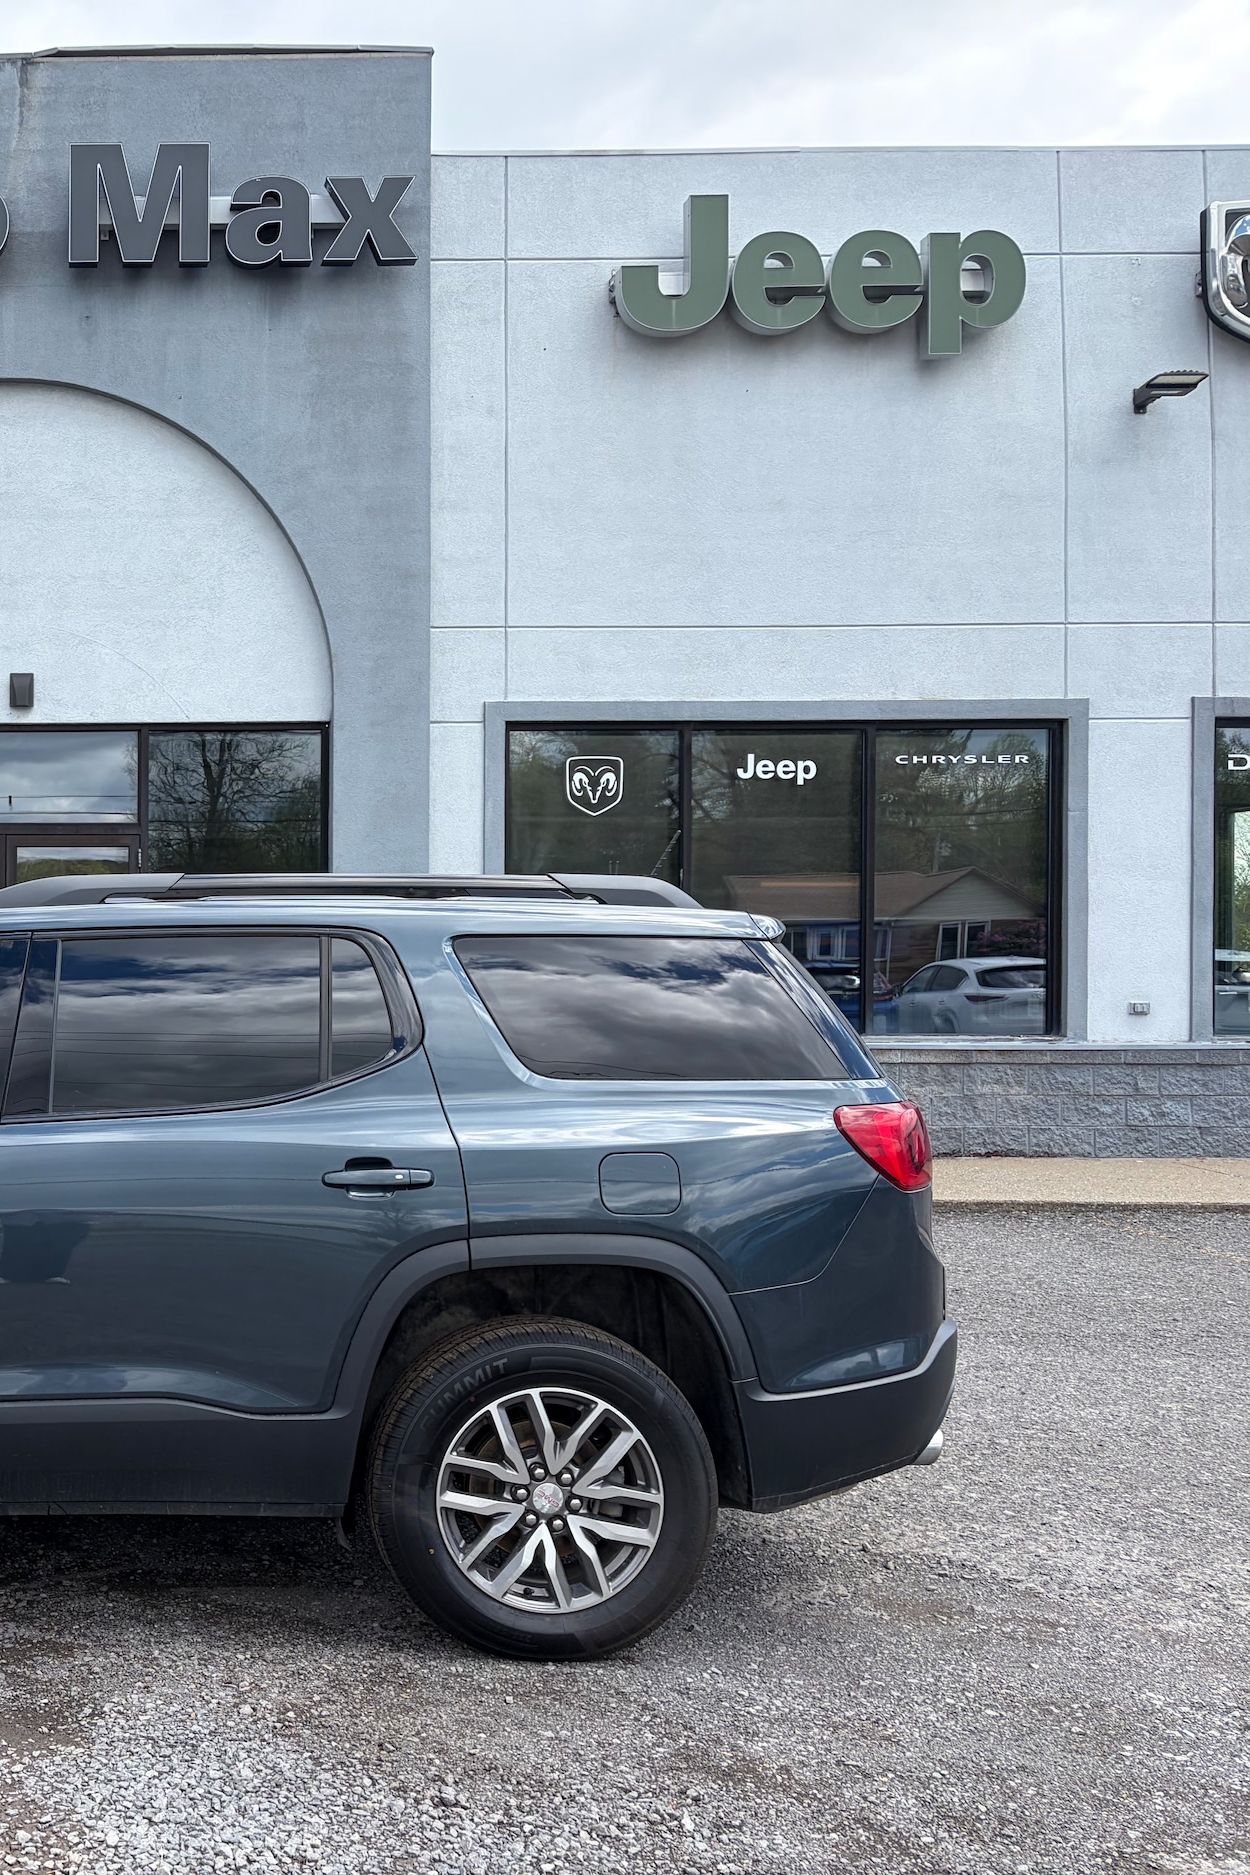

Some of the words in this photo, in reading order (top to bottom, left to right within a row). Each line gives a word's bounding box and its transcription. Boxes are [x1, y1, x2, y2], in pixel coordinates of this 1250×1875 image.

[68, 141, 419, 268] Max
[617, 194, 1027, 358] Jeep
[736, 753, 818, 786] Jeep
[894, 754, 1030, 765] CHRYSLER
